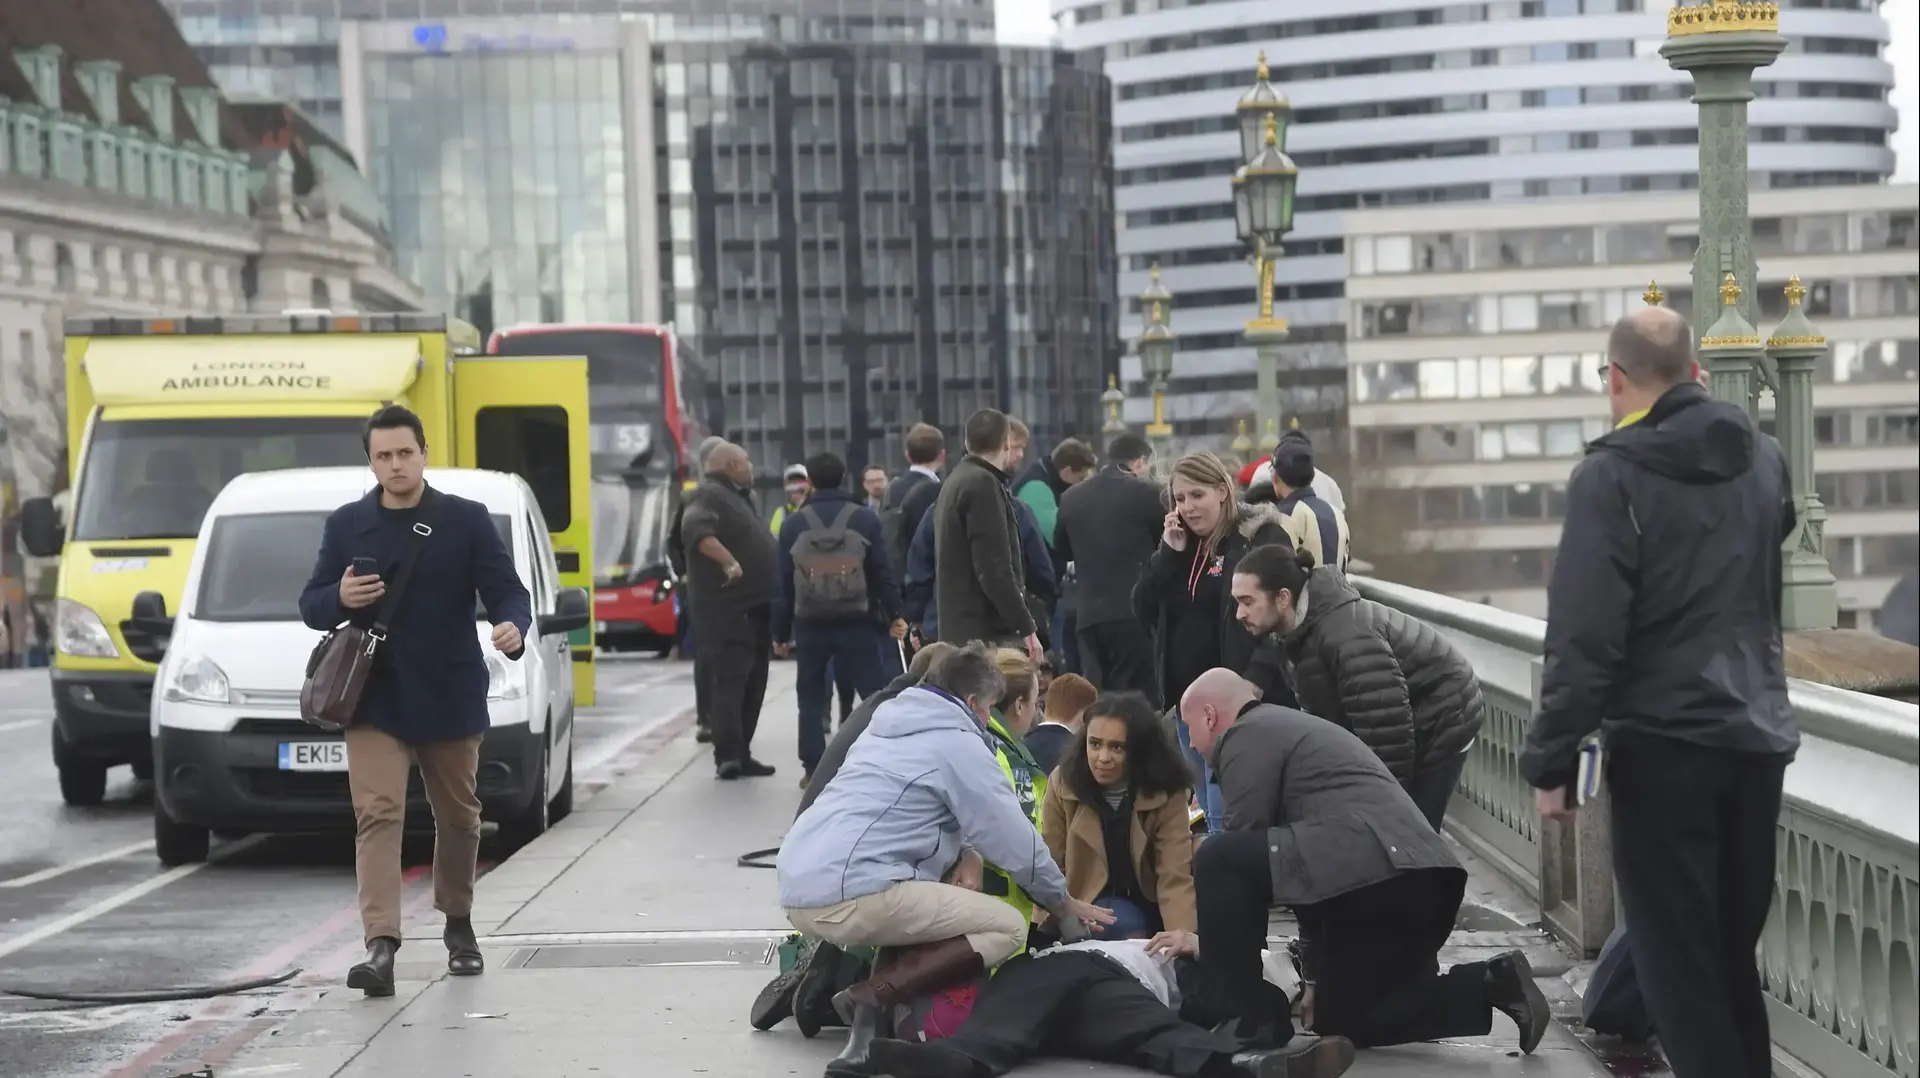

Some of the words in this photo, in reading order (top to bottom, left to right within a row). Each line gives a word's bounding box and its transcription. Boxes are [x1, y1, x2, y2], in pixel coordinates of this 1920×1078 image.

[192, 361, 306, 371] LONDON
[161, 374, 332, 391] AMBULANCE
[618, 424, 650, 451] 53
[296, 744, 343, 764] EK15
